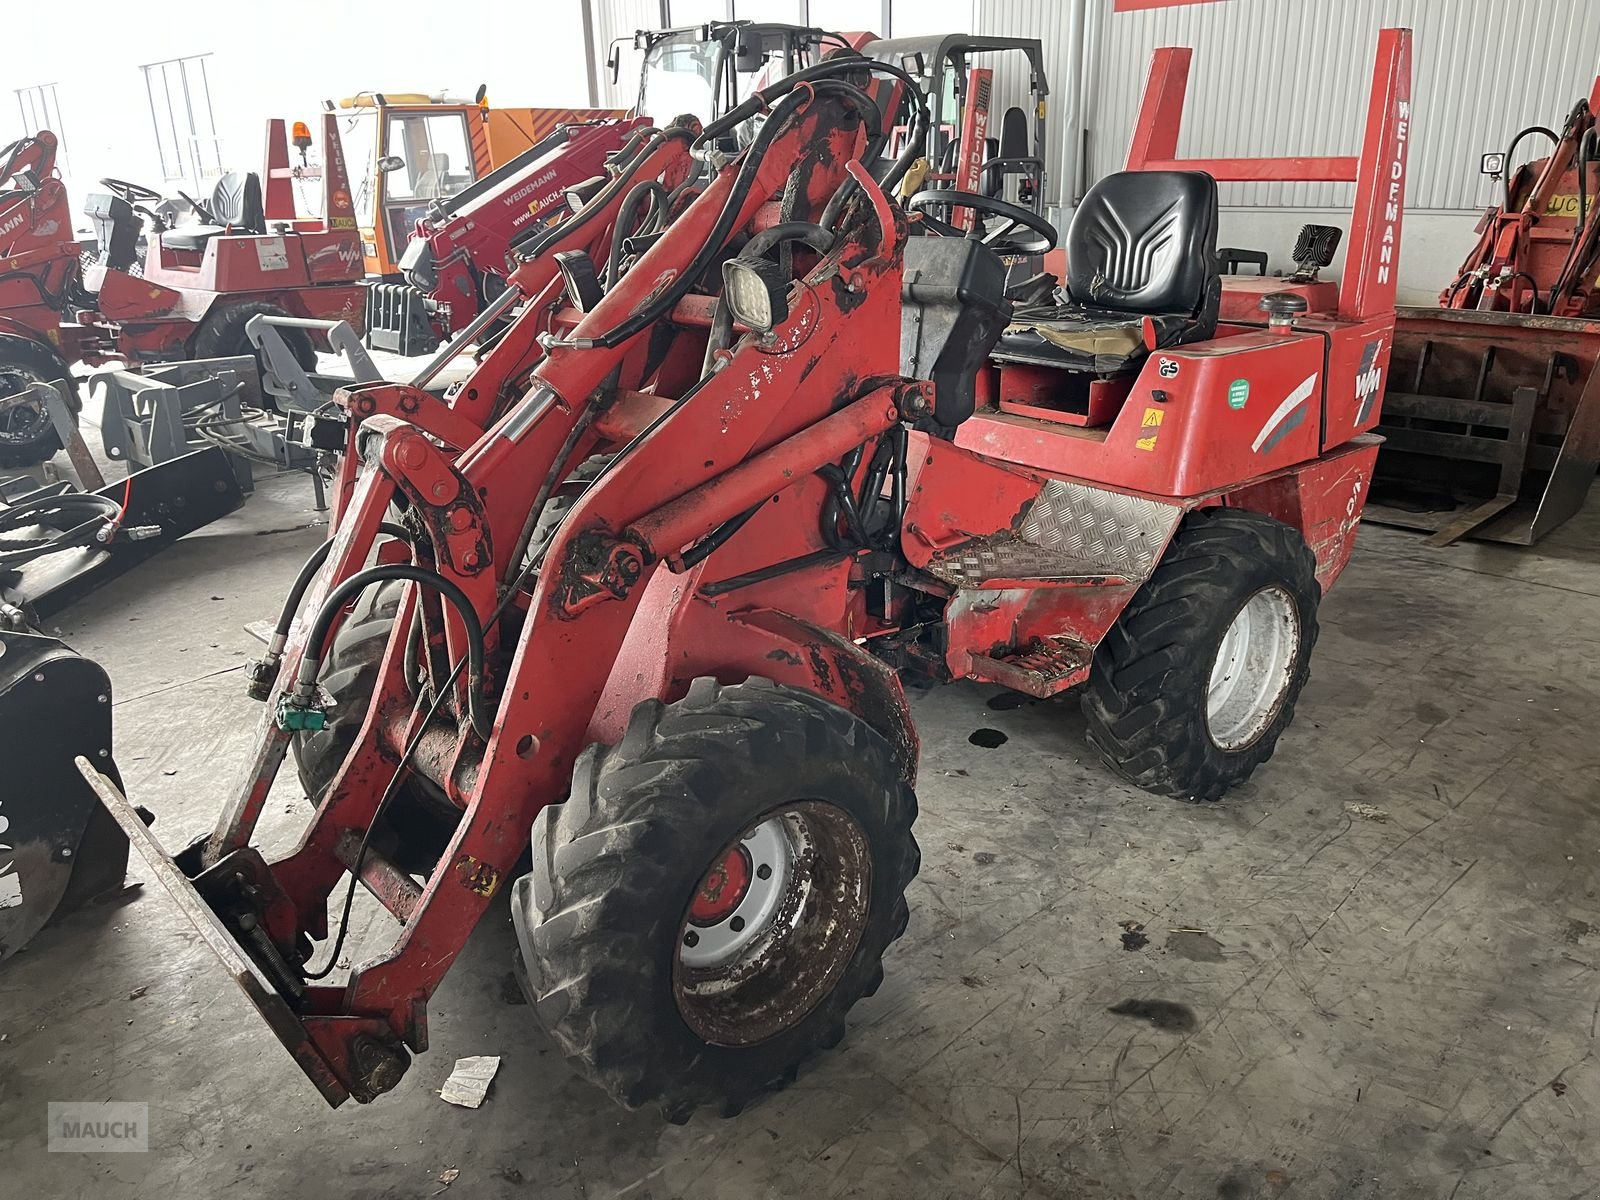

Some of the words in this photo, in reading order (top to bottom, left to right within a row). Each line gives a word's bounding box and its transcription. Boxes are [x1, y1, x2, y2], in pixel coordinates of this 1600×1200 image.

[503, 169, 558, 207] WEIDEMANN
[962, 111, 987, 232] WEIDEMNN
[1377, 101, 1410, 285] WEIDEMANN
